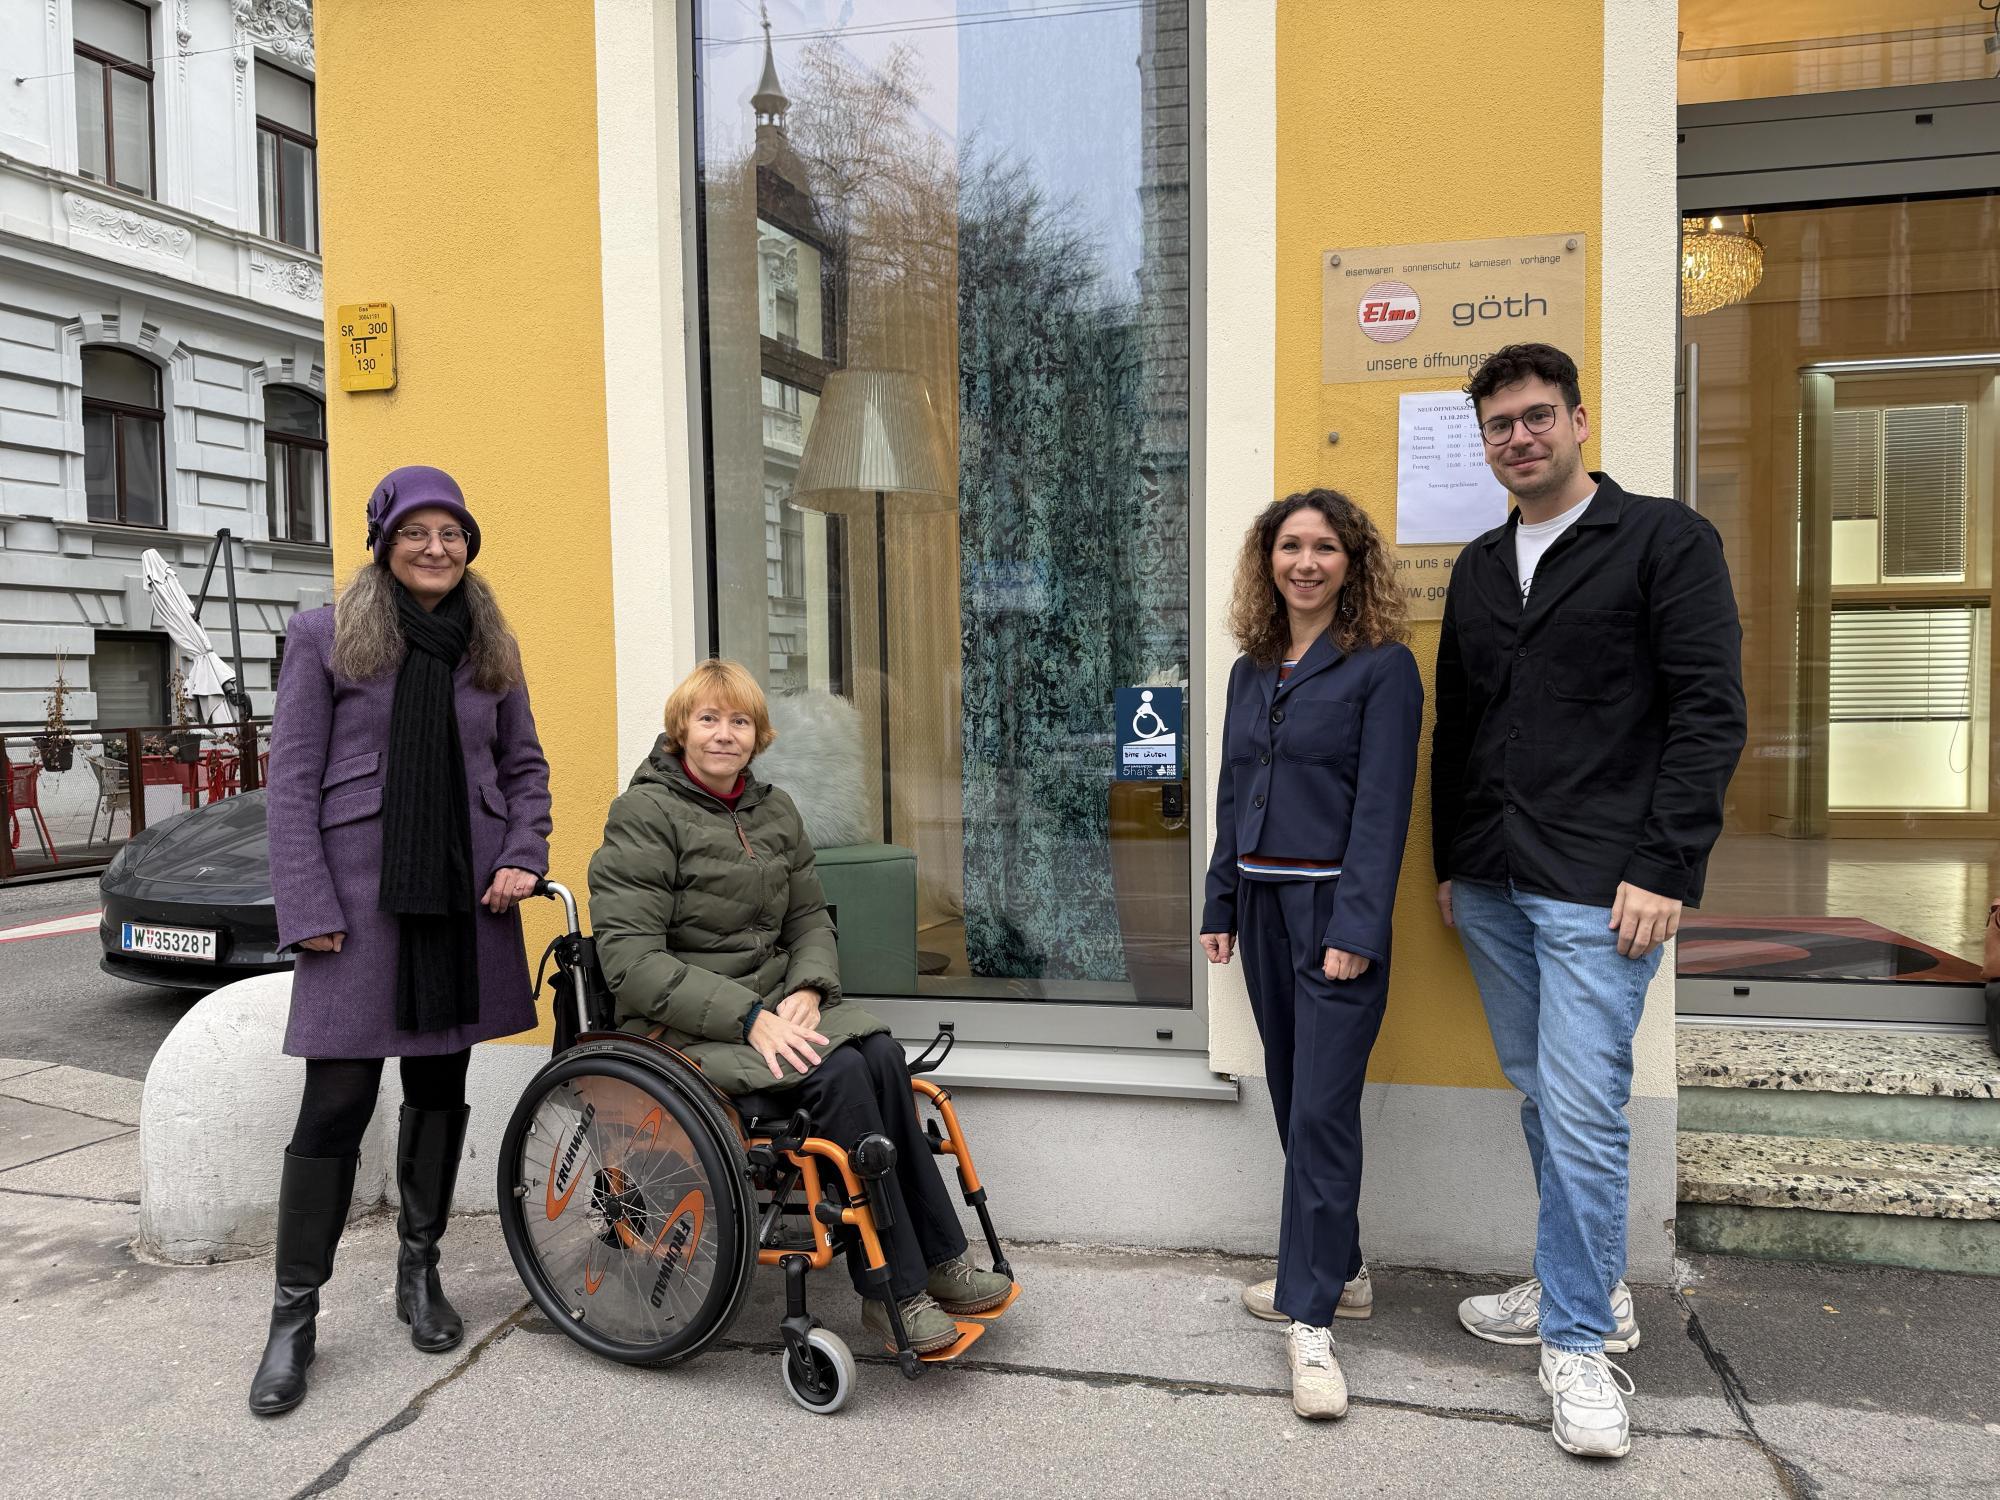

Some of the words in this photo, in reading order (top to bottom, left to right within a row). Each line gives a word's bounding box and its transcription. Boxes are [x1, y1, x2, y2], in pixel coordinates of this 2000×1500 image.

[1345, 266, 1394, 277] eisenwaren
[1402, 260, 1461, 273] sonnenschutz
[1469, 258, 1512, 269] karniesen
[1362, 302, 1417, 324] Elmo
[1452, 292, 1547, 327] göth
[341, 325, 354, 337] SR
[368, 322, 388, 335] 300
[1367, 357, 1418, 371] unsere
[1415, 558, 1438, 569] uns
[134, 928, 145, 947] W
[555, 1102, 596, 1193] FRÜHWALD
[650, 1219, 691, 1309] FRÜHWALD
